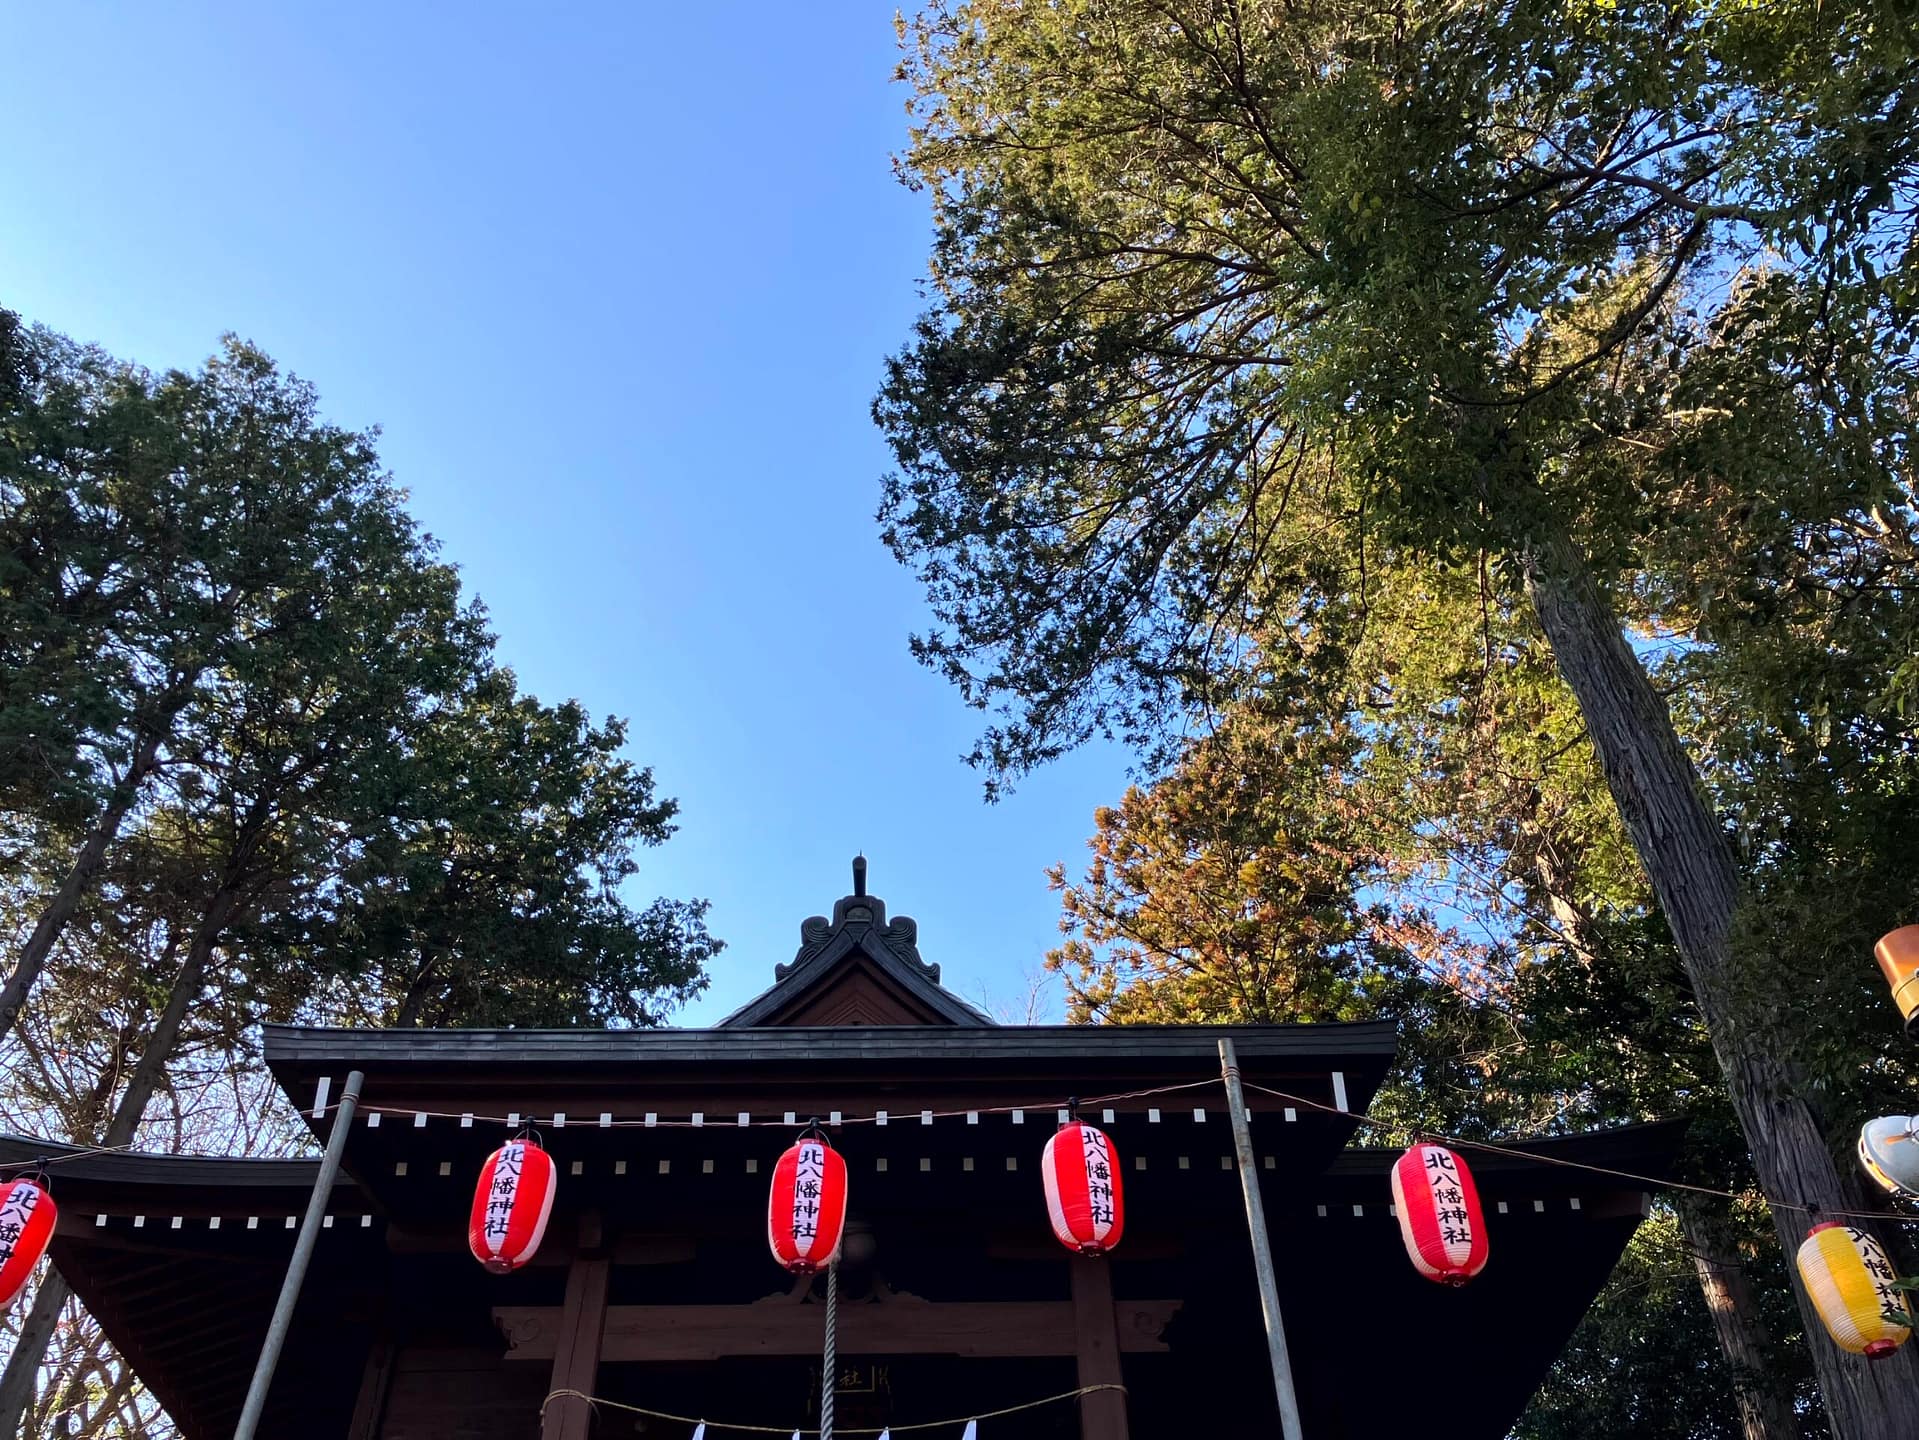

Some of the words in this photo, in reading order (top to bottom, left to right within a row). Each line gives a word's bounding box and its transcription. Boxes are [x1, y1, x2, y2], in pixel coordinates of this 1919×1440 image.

[484, 1148, 525, 1237] 北八幡神社
[792, 1149, 824, 1240] 北八幡神社
[1082, 1130, 1113, 1225] 北八幡神社
[1425, 1152, 1472, 1244] 北八幡神社
